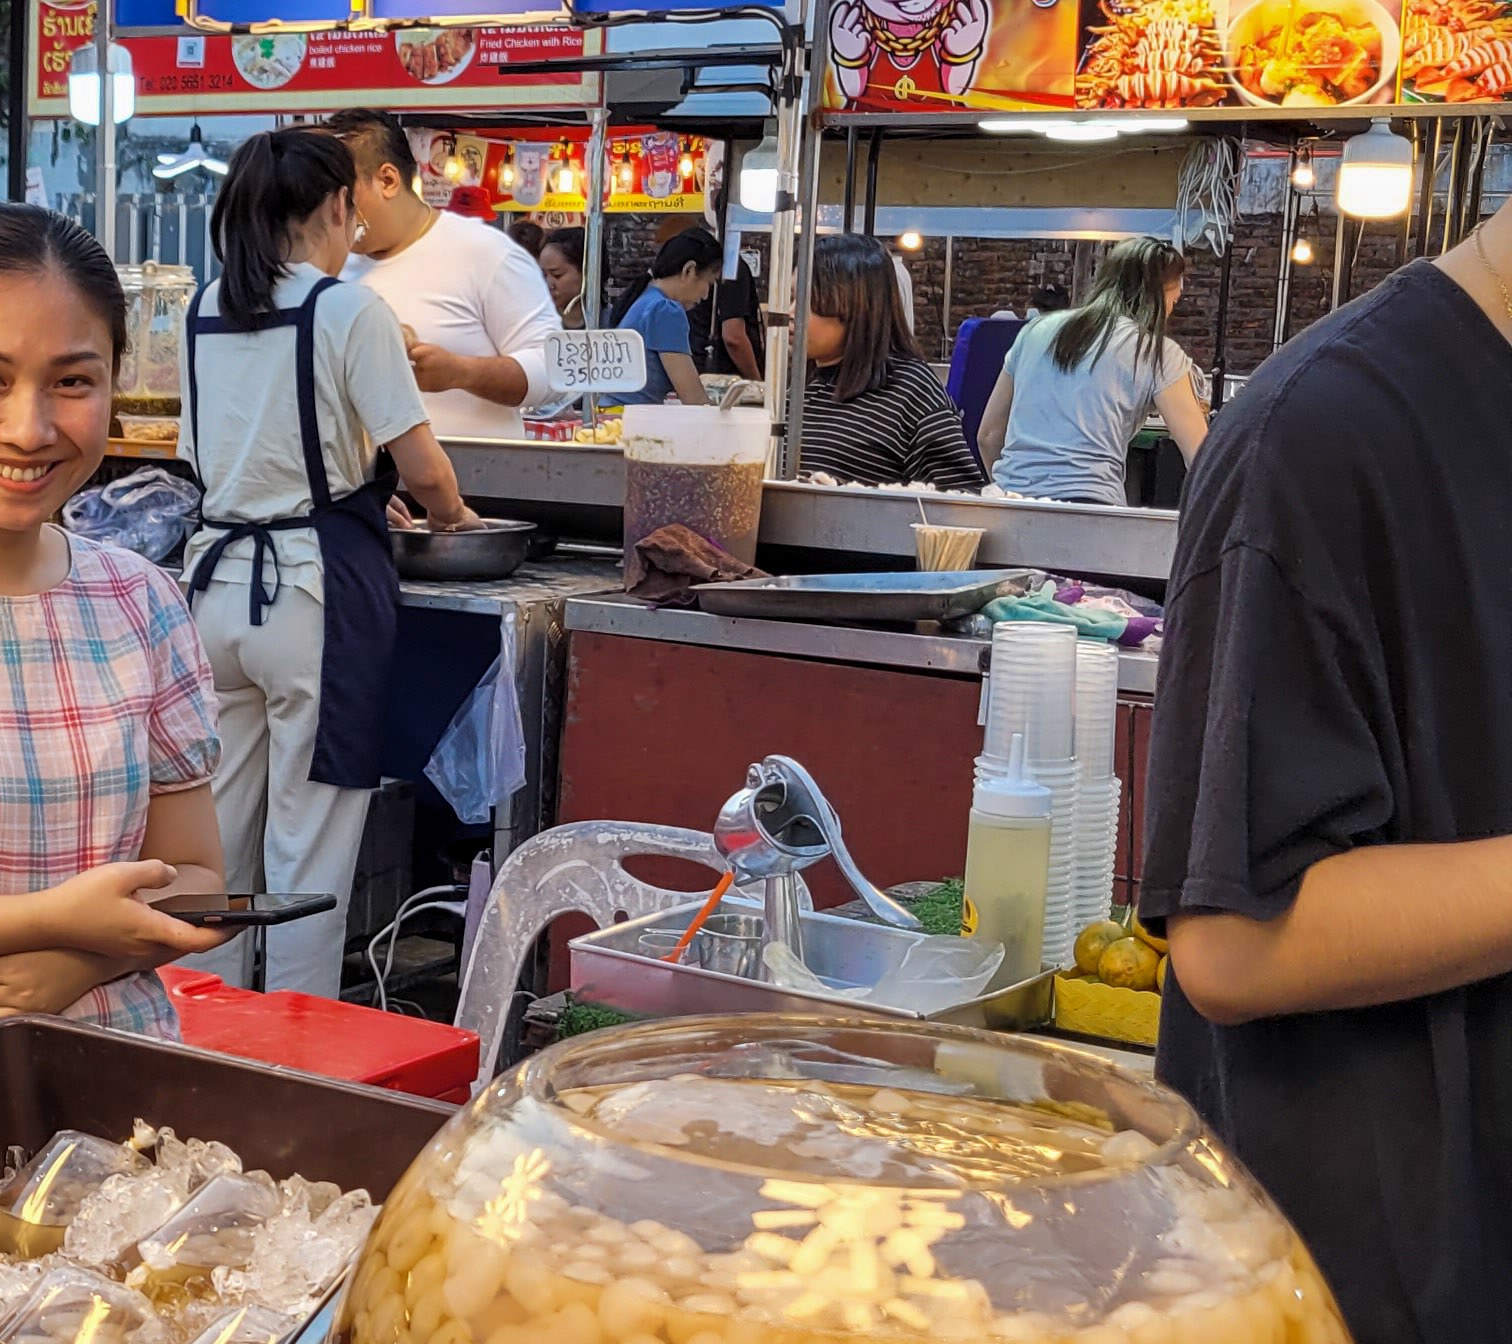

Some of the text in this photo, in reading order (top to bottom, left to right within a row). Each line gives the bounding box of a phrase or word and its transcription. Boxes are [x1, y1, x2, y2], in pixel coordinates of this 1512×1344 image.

[480, 36, 582, 49] Fried Chicken with Rice
[335, 44, 364, 54] chicken
